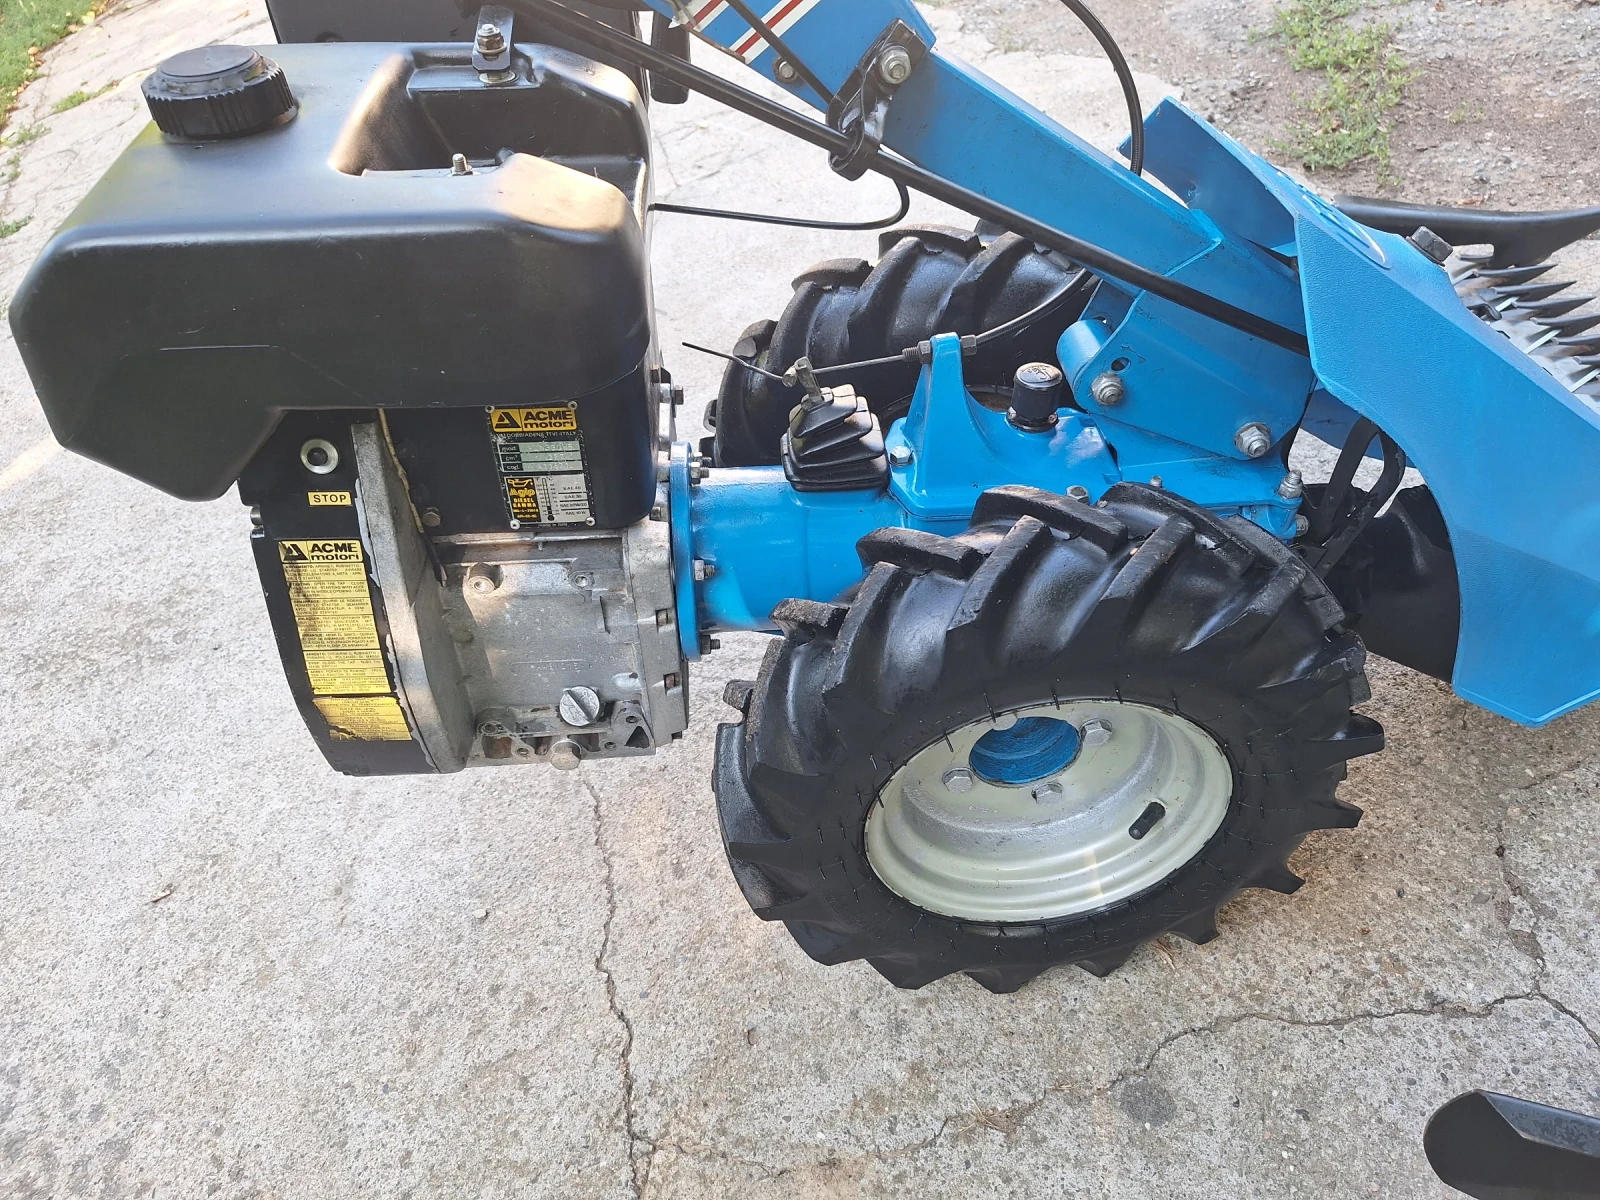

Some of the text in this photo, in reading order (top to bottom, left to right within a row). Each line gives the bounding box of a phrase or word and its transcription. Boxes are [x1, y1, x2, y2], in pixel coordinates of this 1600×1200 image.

[523, 410, 573, 421] ACME
[523, 421, 574, 429] motori
[509, 488, 535, 497] Agip
[313, 494, 347, 503] STOP
[311, 542, 358, 553] ACME
[311, 553, 359, 561] motori
